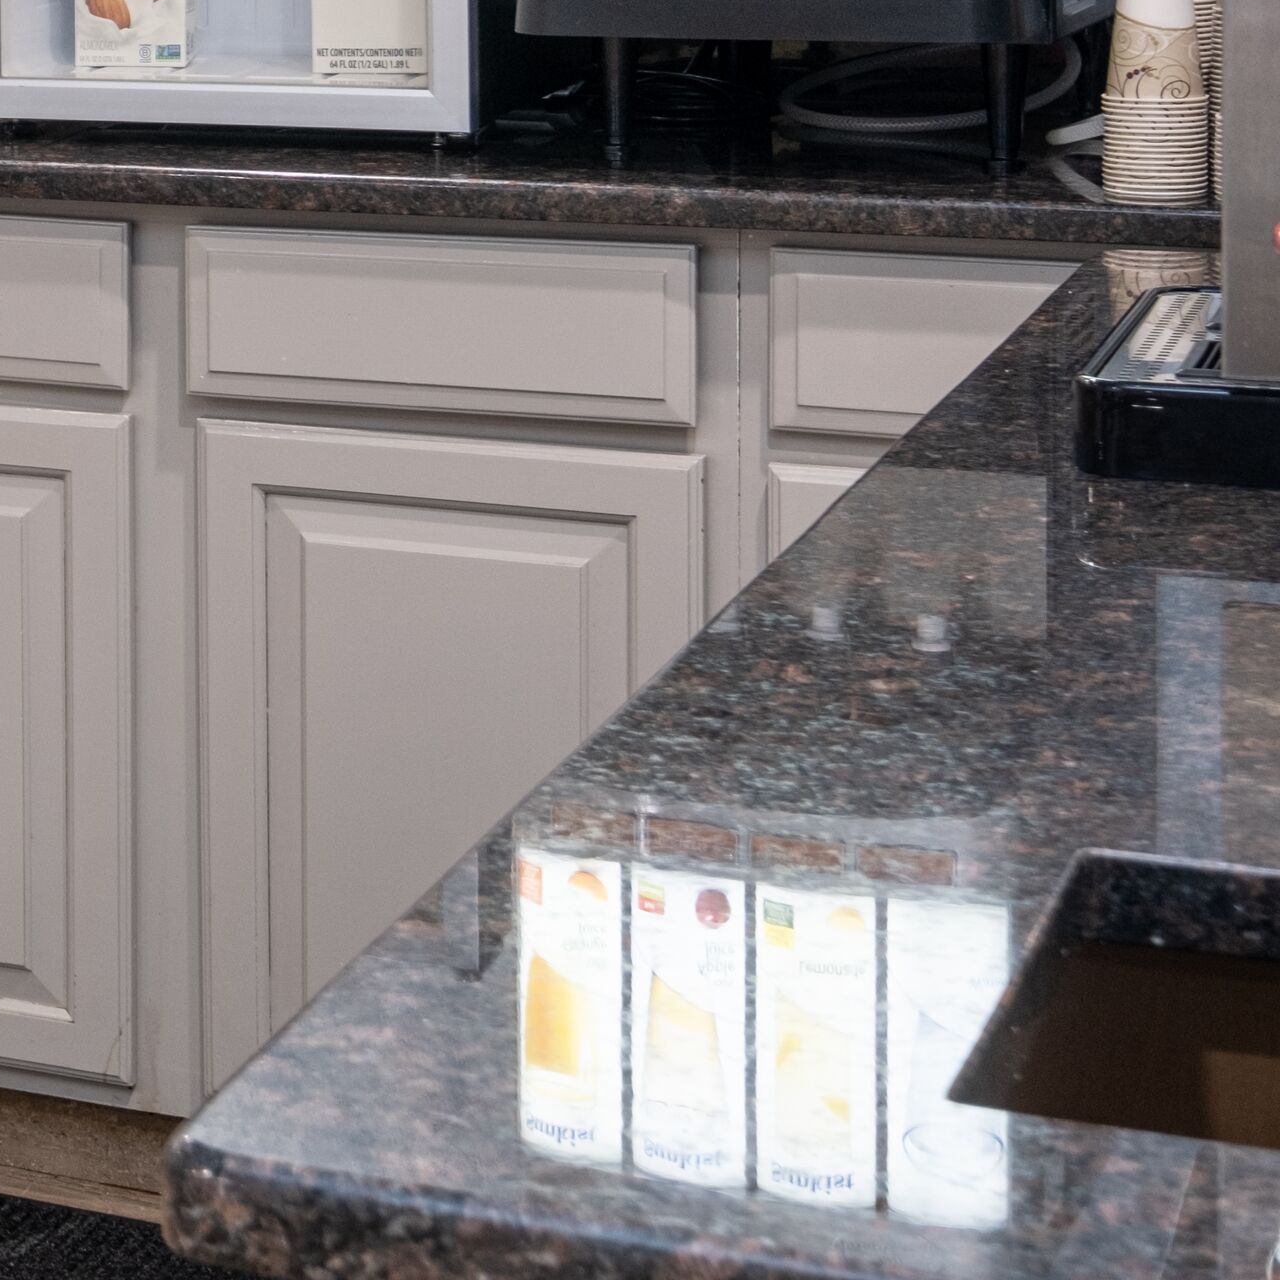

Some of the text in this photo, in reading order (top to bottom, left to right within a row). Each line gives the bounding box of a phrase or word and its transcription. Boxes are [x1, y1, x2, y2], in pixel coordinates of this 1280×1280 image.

[316, 47, 329, 57] NET
[329, 60, 338, 69] 64
[339, 60, 347, 69] FL
[348, 60, 357, 69] OZ
